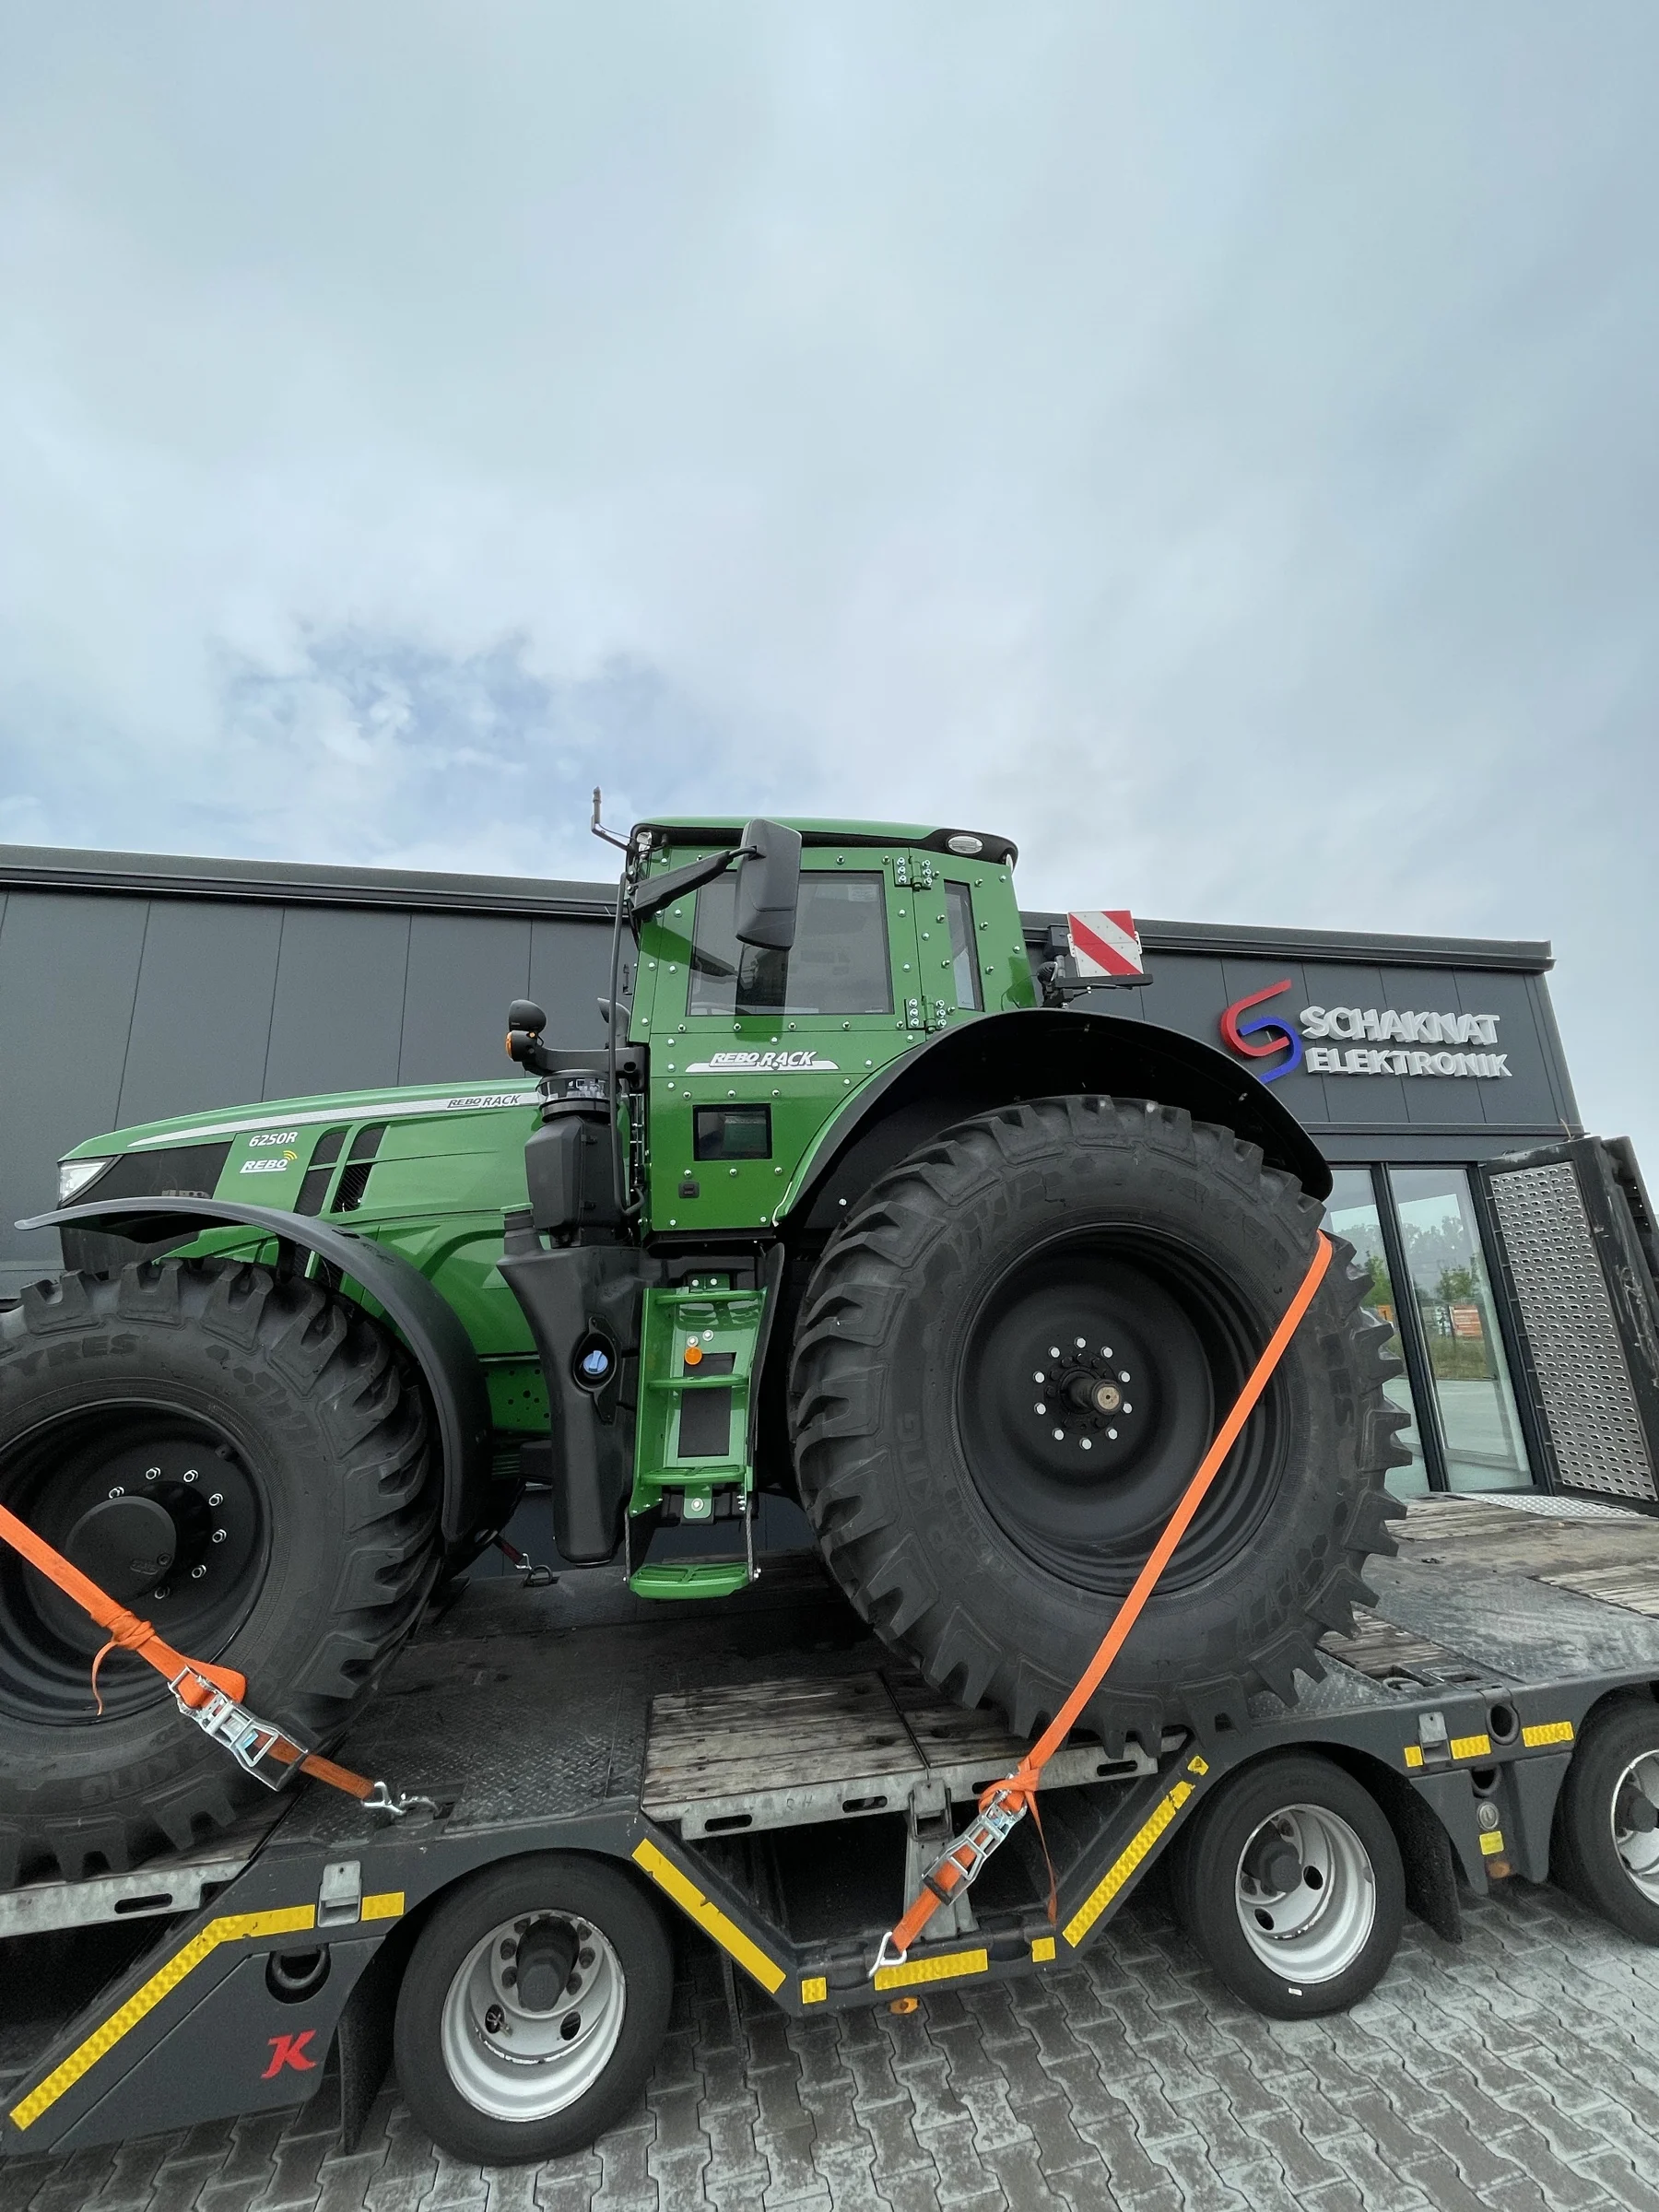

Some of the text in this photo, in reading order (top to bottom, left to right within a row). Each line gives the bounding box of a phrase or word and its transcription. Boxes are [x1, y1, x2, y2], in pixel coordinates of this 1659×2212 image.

[1300, 1006, 1500, 1045] SCHAKNAT
[709, 1051, 818, 1066] REBO RACK
[1305, 1047, 1512, 1077] ELEKTRONIK
[447, 1094, 521, 1108] REBO RACK
[249, 1132, 298, 1147] 6250R
[240, 1159, 288, 1173] REBO
[6, 1334, 139, 1377] YRES
